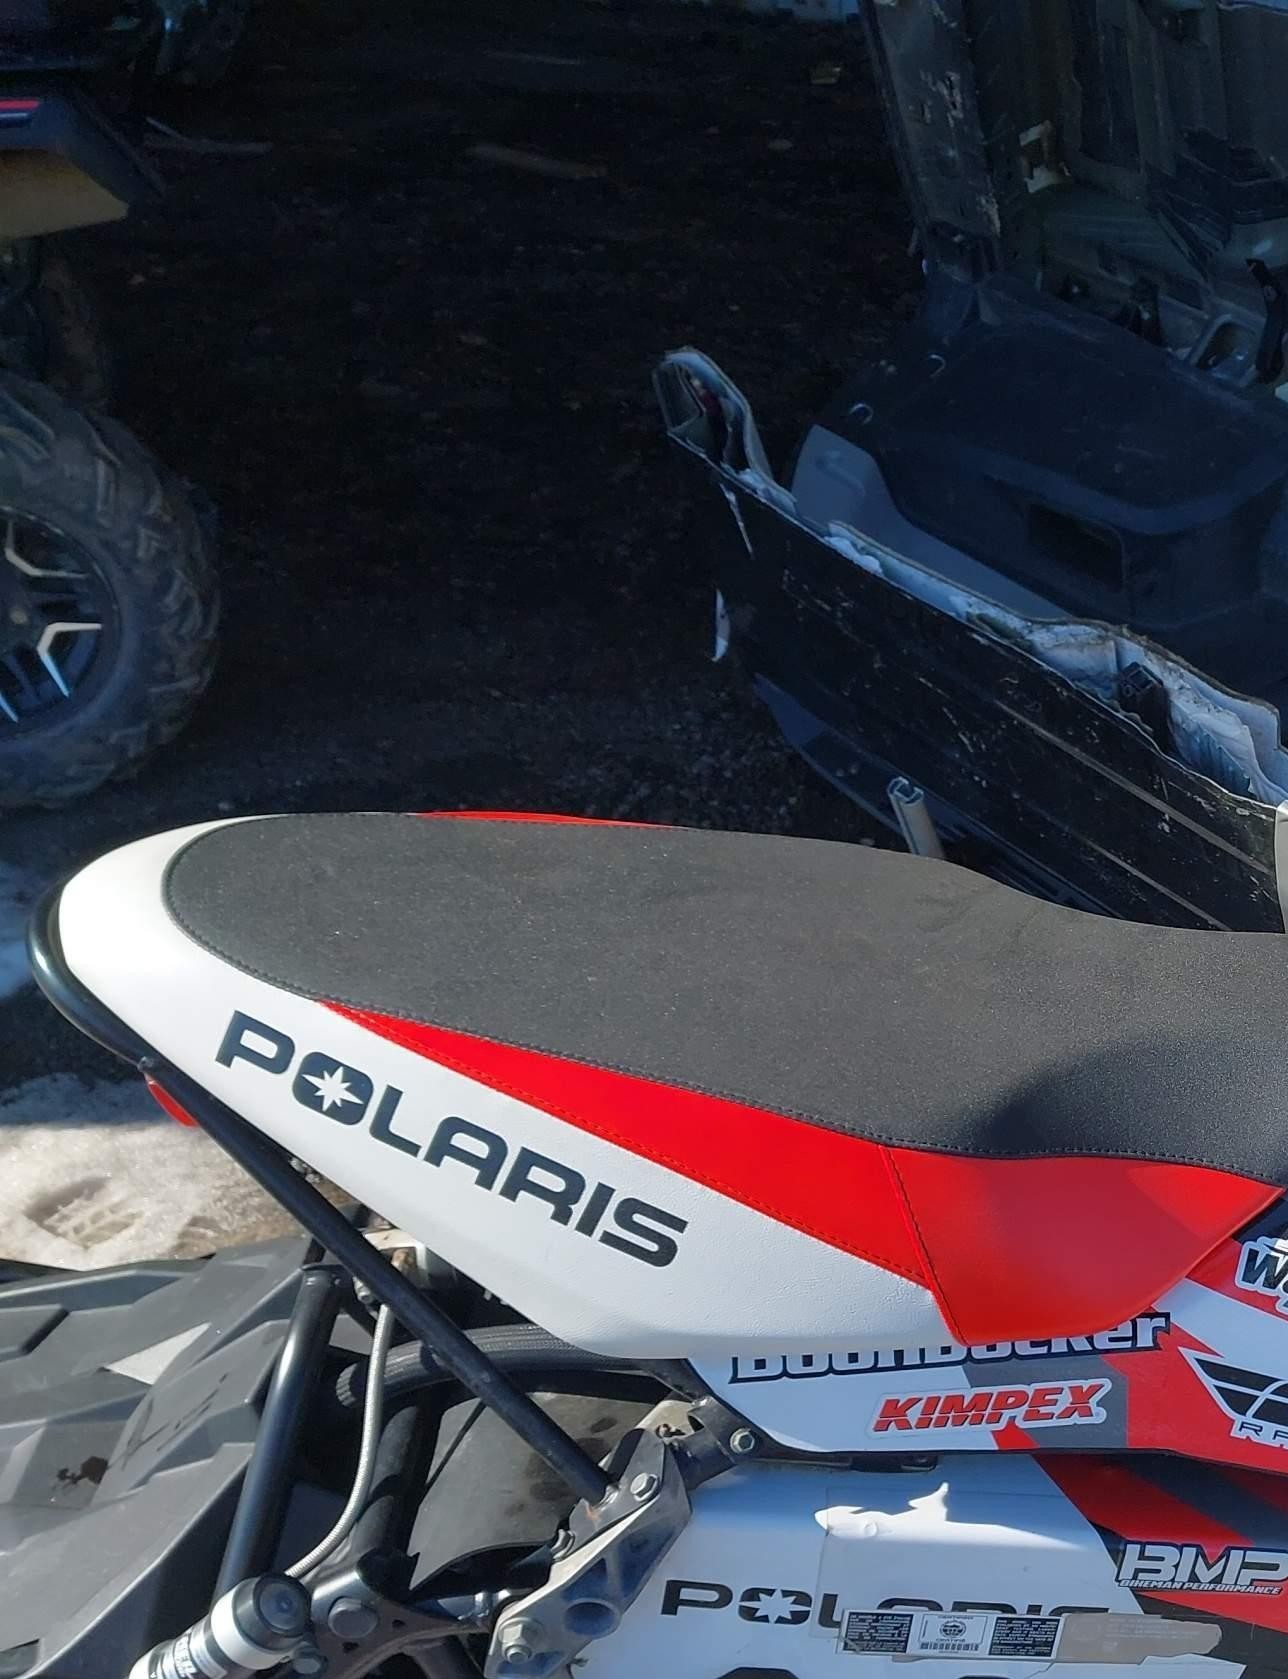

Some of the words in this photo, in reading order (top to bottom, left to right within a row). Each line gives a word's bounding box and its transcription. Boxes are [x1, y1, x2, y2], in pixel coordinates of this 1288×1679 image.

[215, 1010, 689, 1268] POLARIS
[874, 1383, 1104, 1432] KIMPEX
[1183, 1581, 1283, 1595] PERFORMANCE
